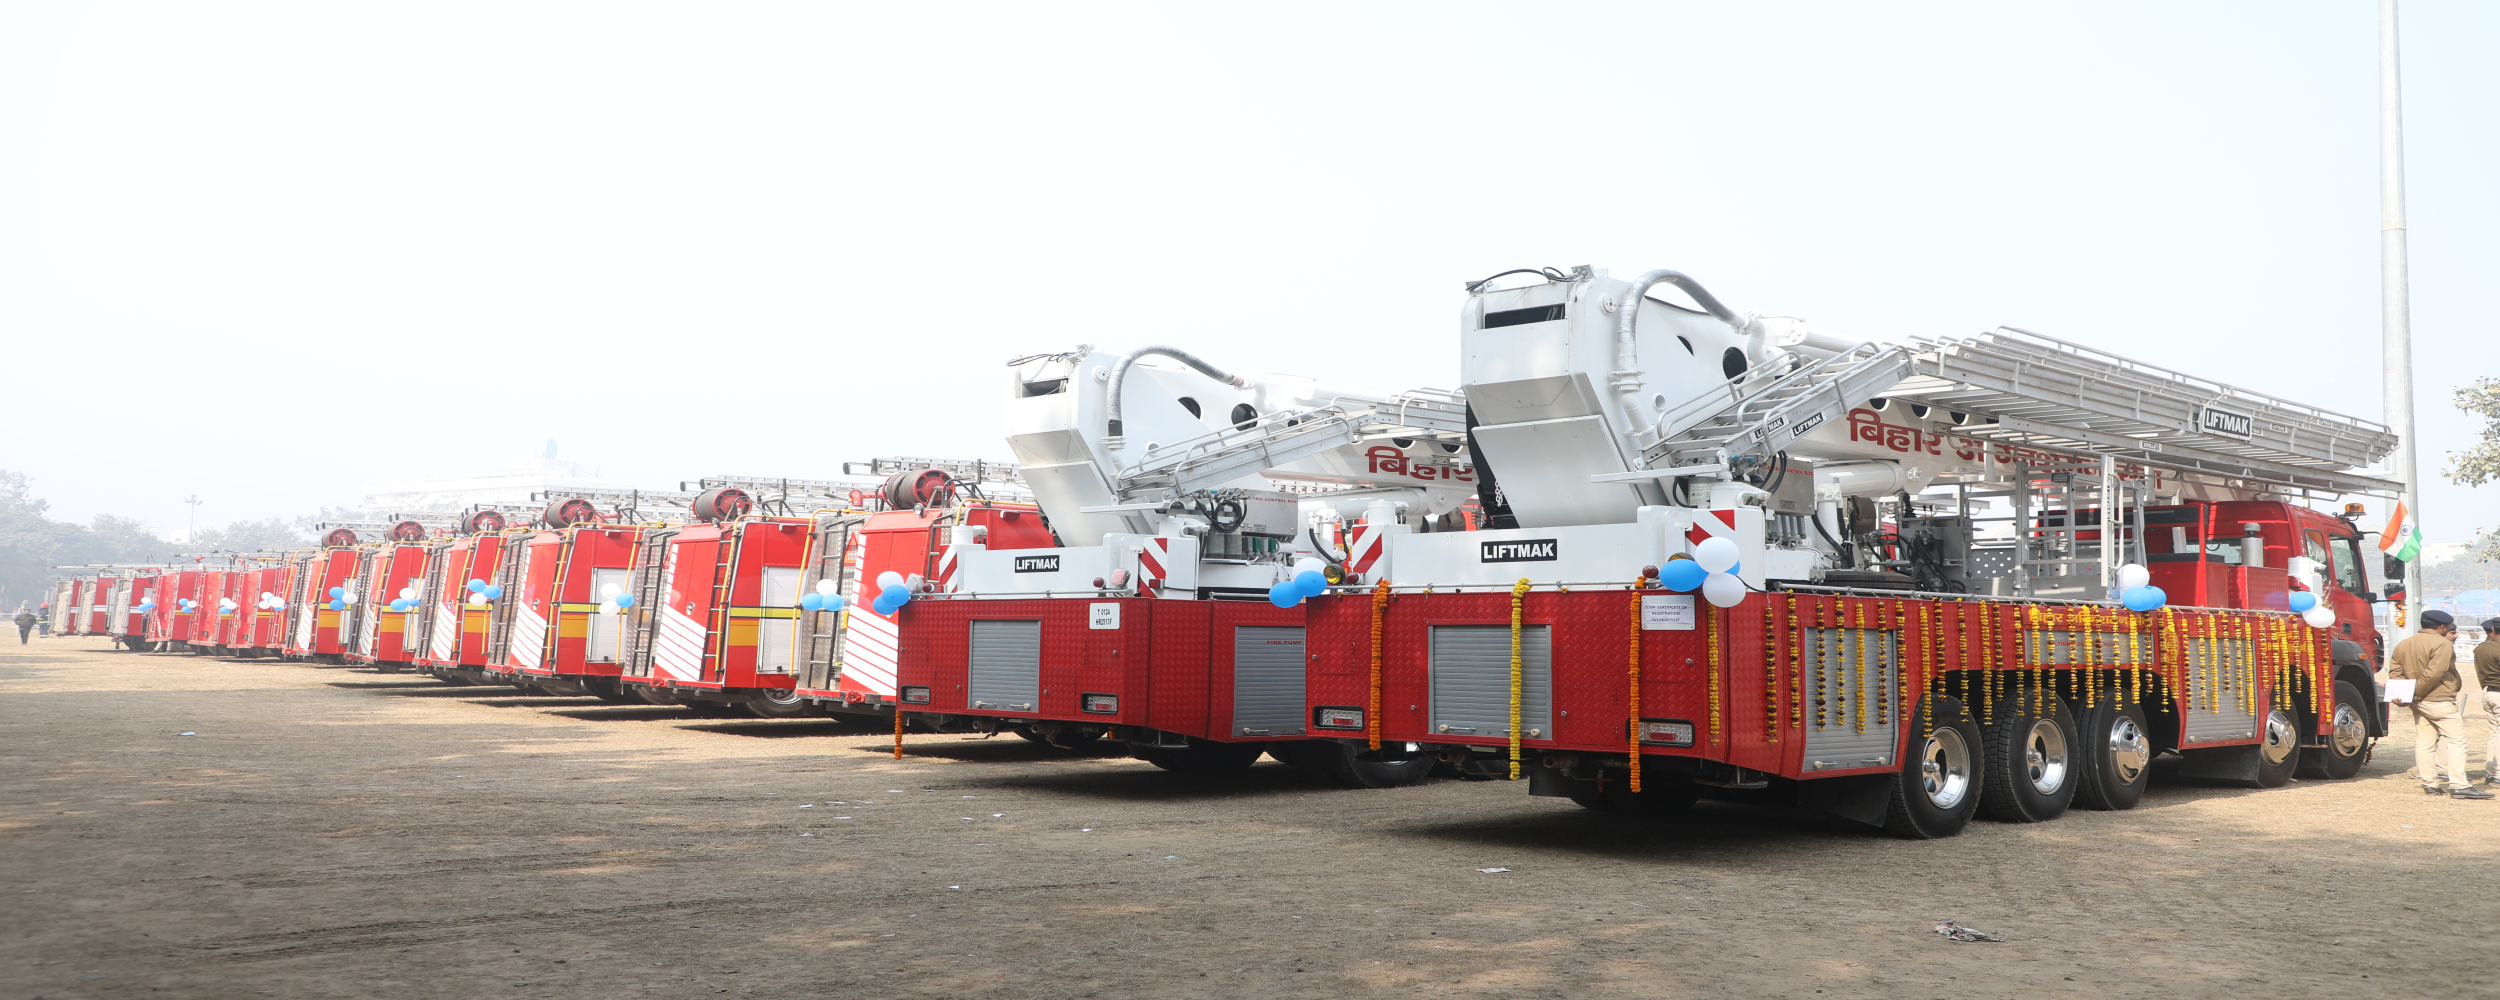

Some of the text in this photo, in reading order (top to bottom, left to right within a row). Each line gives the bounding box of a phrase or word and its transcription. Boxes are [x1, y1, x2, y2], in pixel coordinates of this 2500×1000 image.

[1756, 419, 1783, 438] LITMAK
[1794, 414, 1822, 435] LIFTMAK
[1846, 408, 1945, 456] बिहार
[2205, 410, 2249, 434] LIFTMAK
[1483, 543, 1555, 559] LIFTMAK
[1016, 558, 1058, 570] LIFTMAK
